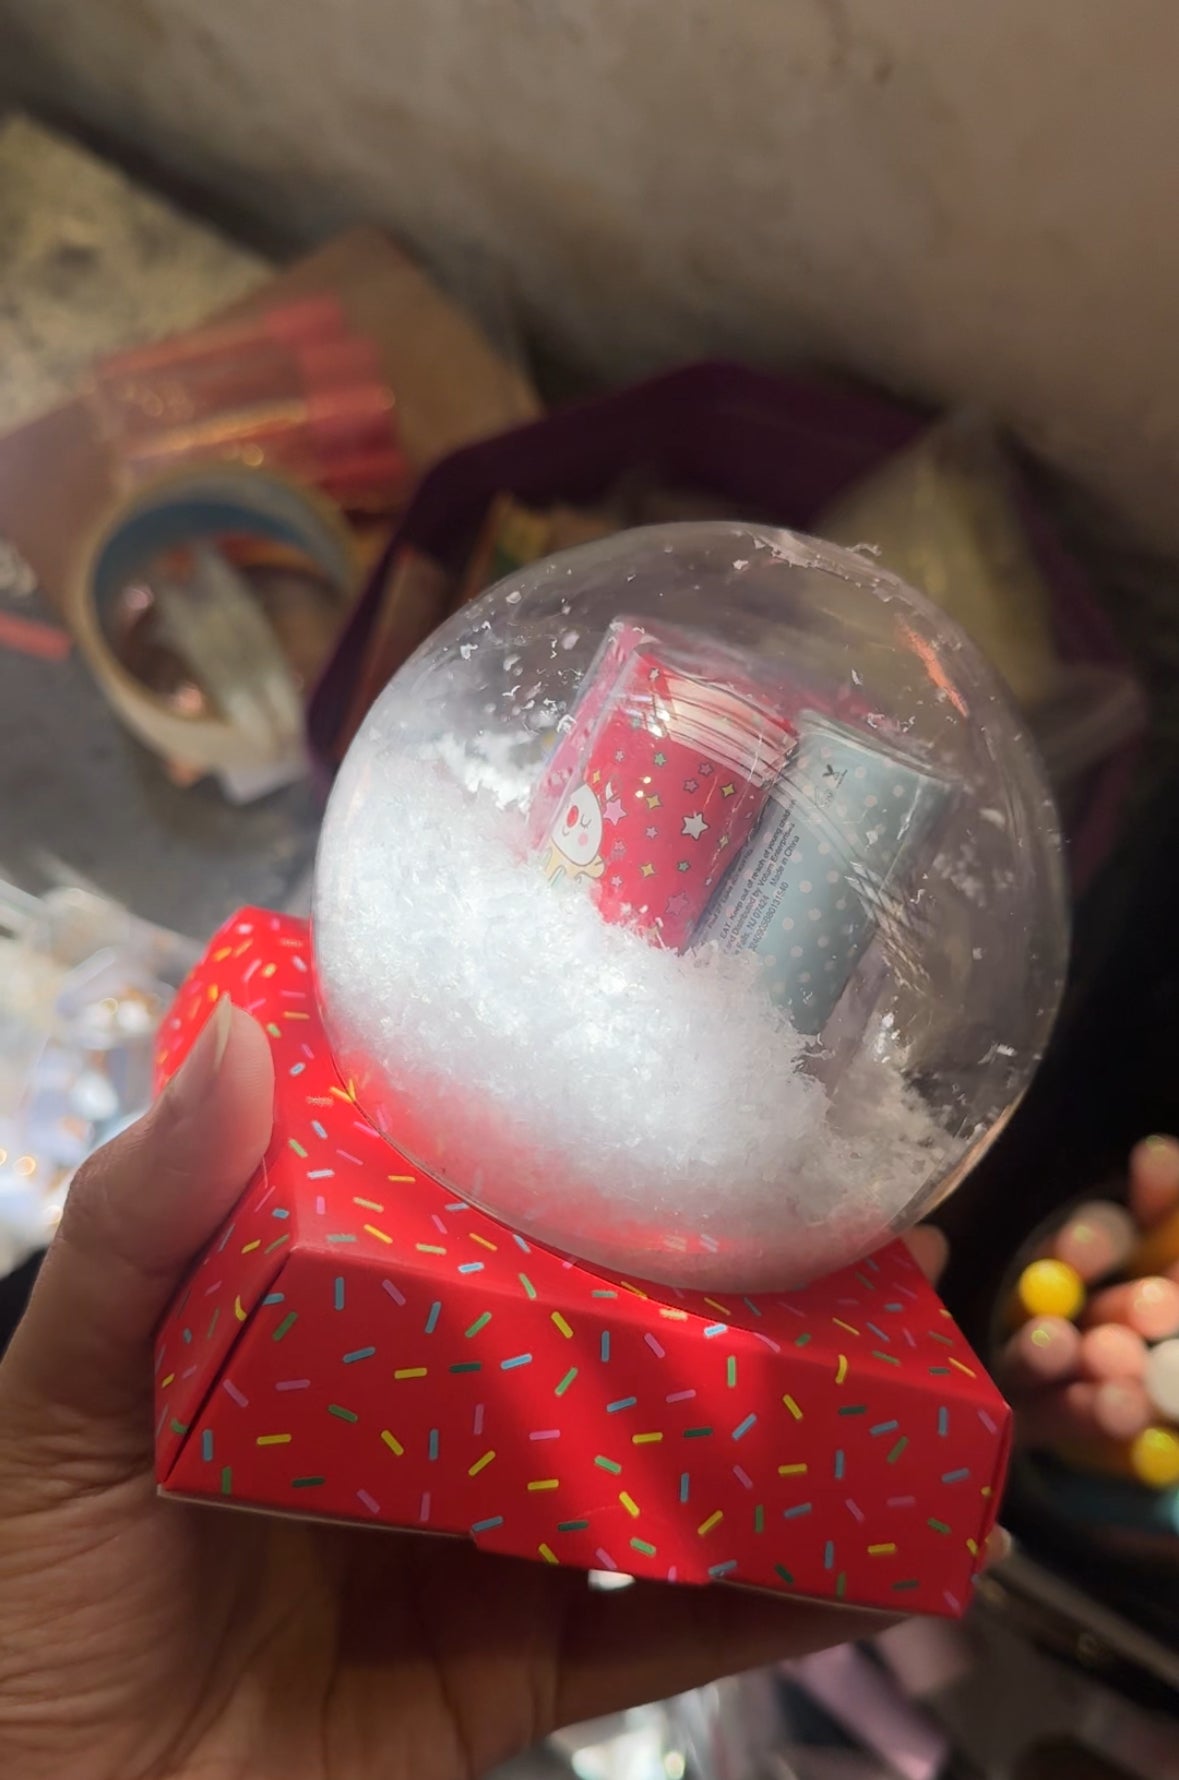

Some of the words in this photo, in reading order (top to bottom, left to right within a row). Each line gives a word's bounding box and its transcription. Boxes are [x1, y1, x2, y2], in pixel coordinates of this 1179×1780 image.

[784, 835, 800, 857] China
[781, 857, 789, 867] in
[730, 901, 743, 920] Keep
[741, 888, 750, 902] out
[747, 878, 754, 889] of
[751, 859, 766, 880] reach
[763, 848, 770, 859] of
[768, 827, 782, 851] young
[769, 866, 785, 887] Made
[731, 896, 756, 936] Distributed
[752, 887, 763, 898] by
[758, 861, 775, 886] Votum
[752, 895, 770, 918] 07424
[746, 917, 757, 930] NJ
